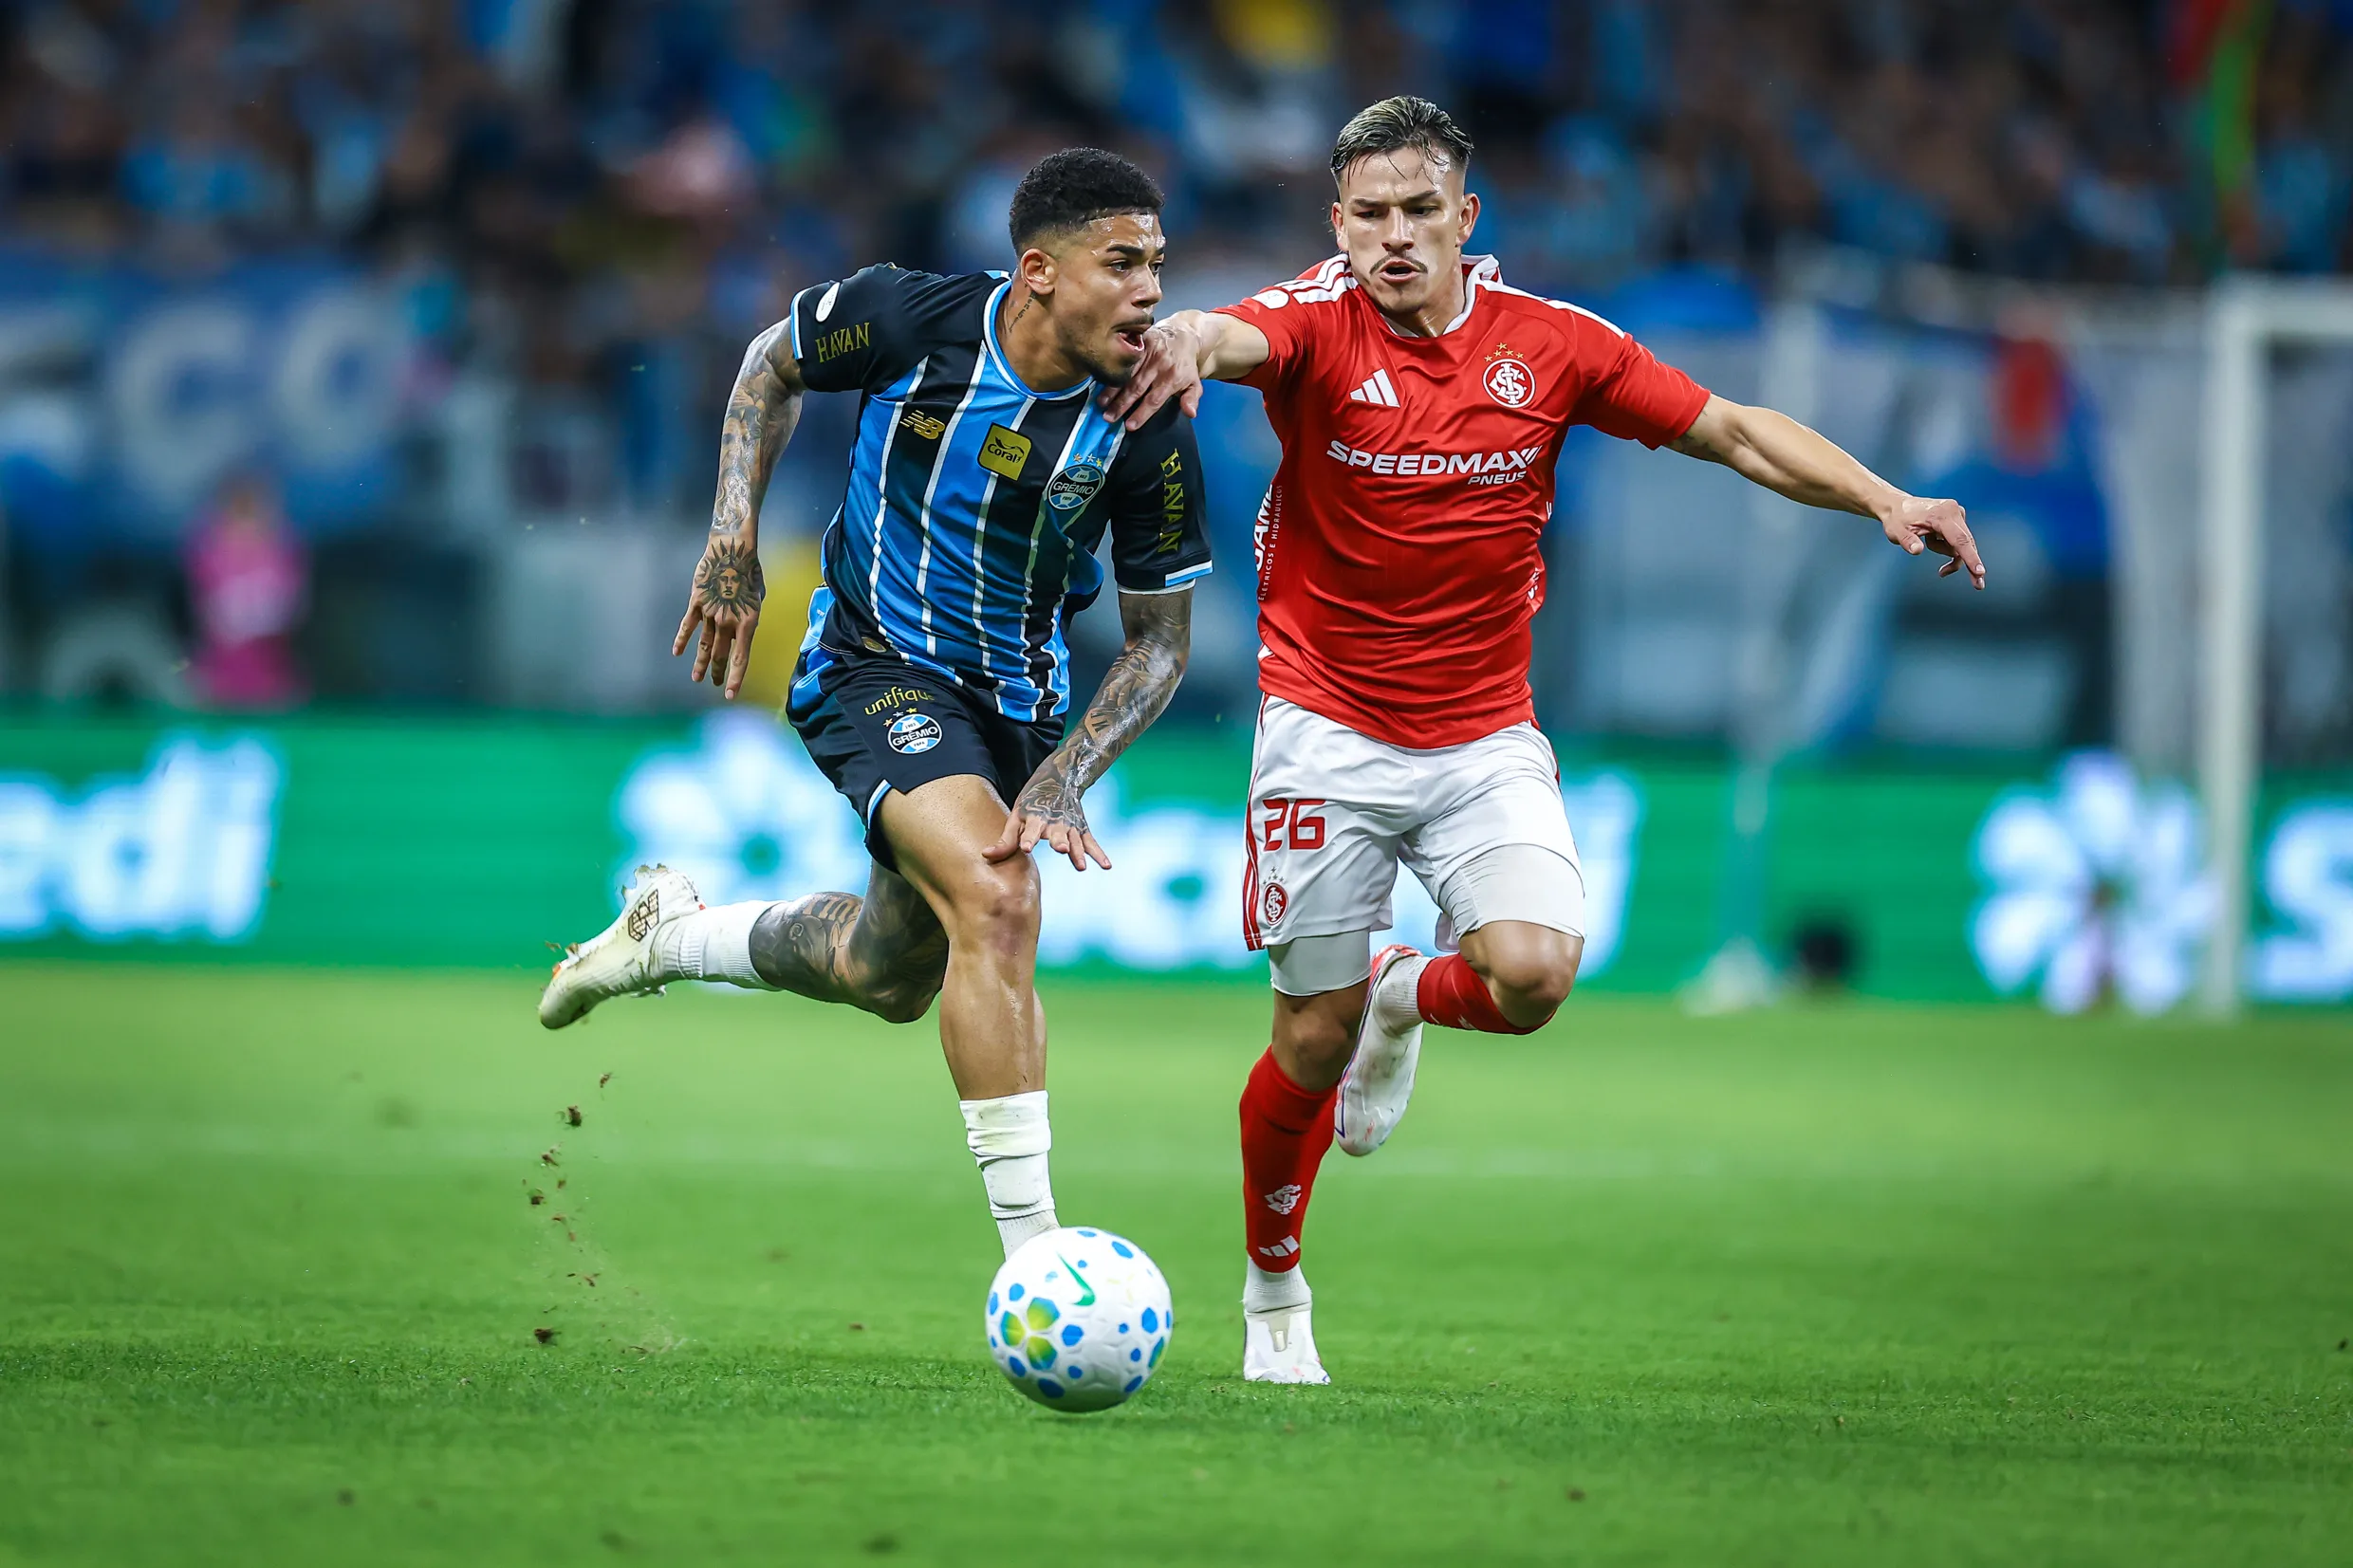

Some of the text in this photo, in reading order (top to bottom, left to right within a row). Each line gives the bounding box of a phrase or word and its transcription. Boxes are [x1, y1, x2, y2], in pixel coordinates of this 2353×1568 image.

[815, 322, 870, 363] HAVAN
[987, 443, 1019, 463] Coral
[1325, 439, 1543, 476] SPEEDMAX
[1467, 470, 1528, 486] PNEUS
[1158, 448, 1184, 553] HAVAN
[863, 686, 936, 715] unifique
[892, 726, 938, 747] GRÊMIO
[1262, 798, 1327, 852] 26
